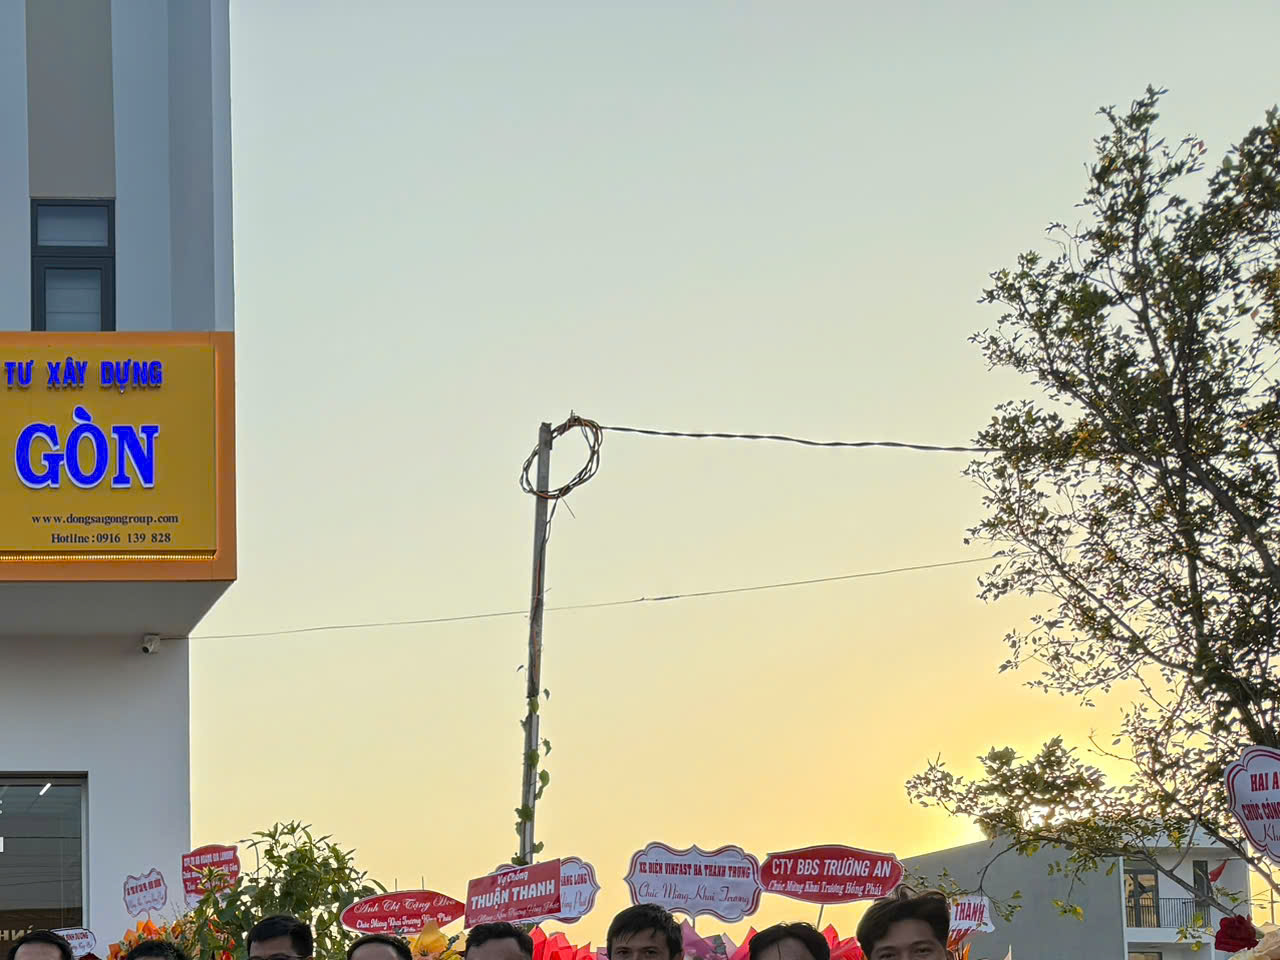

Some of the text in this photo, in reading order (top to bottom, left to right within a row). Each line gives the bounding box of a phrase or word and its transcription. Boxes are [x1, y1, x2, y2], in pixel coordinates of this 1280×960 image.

[4, 359, 35, 388] TƯ
[47, 356, 88, 388] XÂY
[99, 358, 163, 393] DỰNG
[15, 405, 161, 489] GÒN
[127, 533, 146, 543] 139
[151, 533, 172, 543] 828
[1250, 772, 1269, 792] HAI
[639, 862, 648, 873] XE
[665, 862, 692, 876] VINFAST
[772, 858, 793, 876] CTY
[797, 859, 819, 876] BĐS
[873, 860, 892, 878] AN
[471, 879, 556, 910] THUẬN THANH
